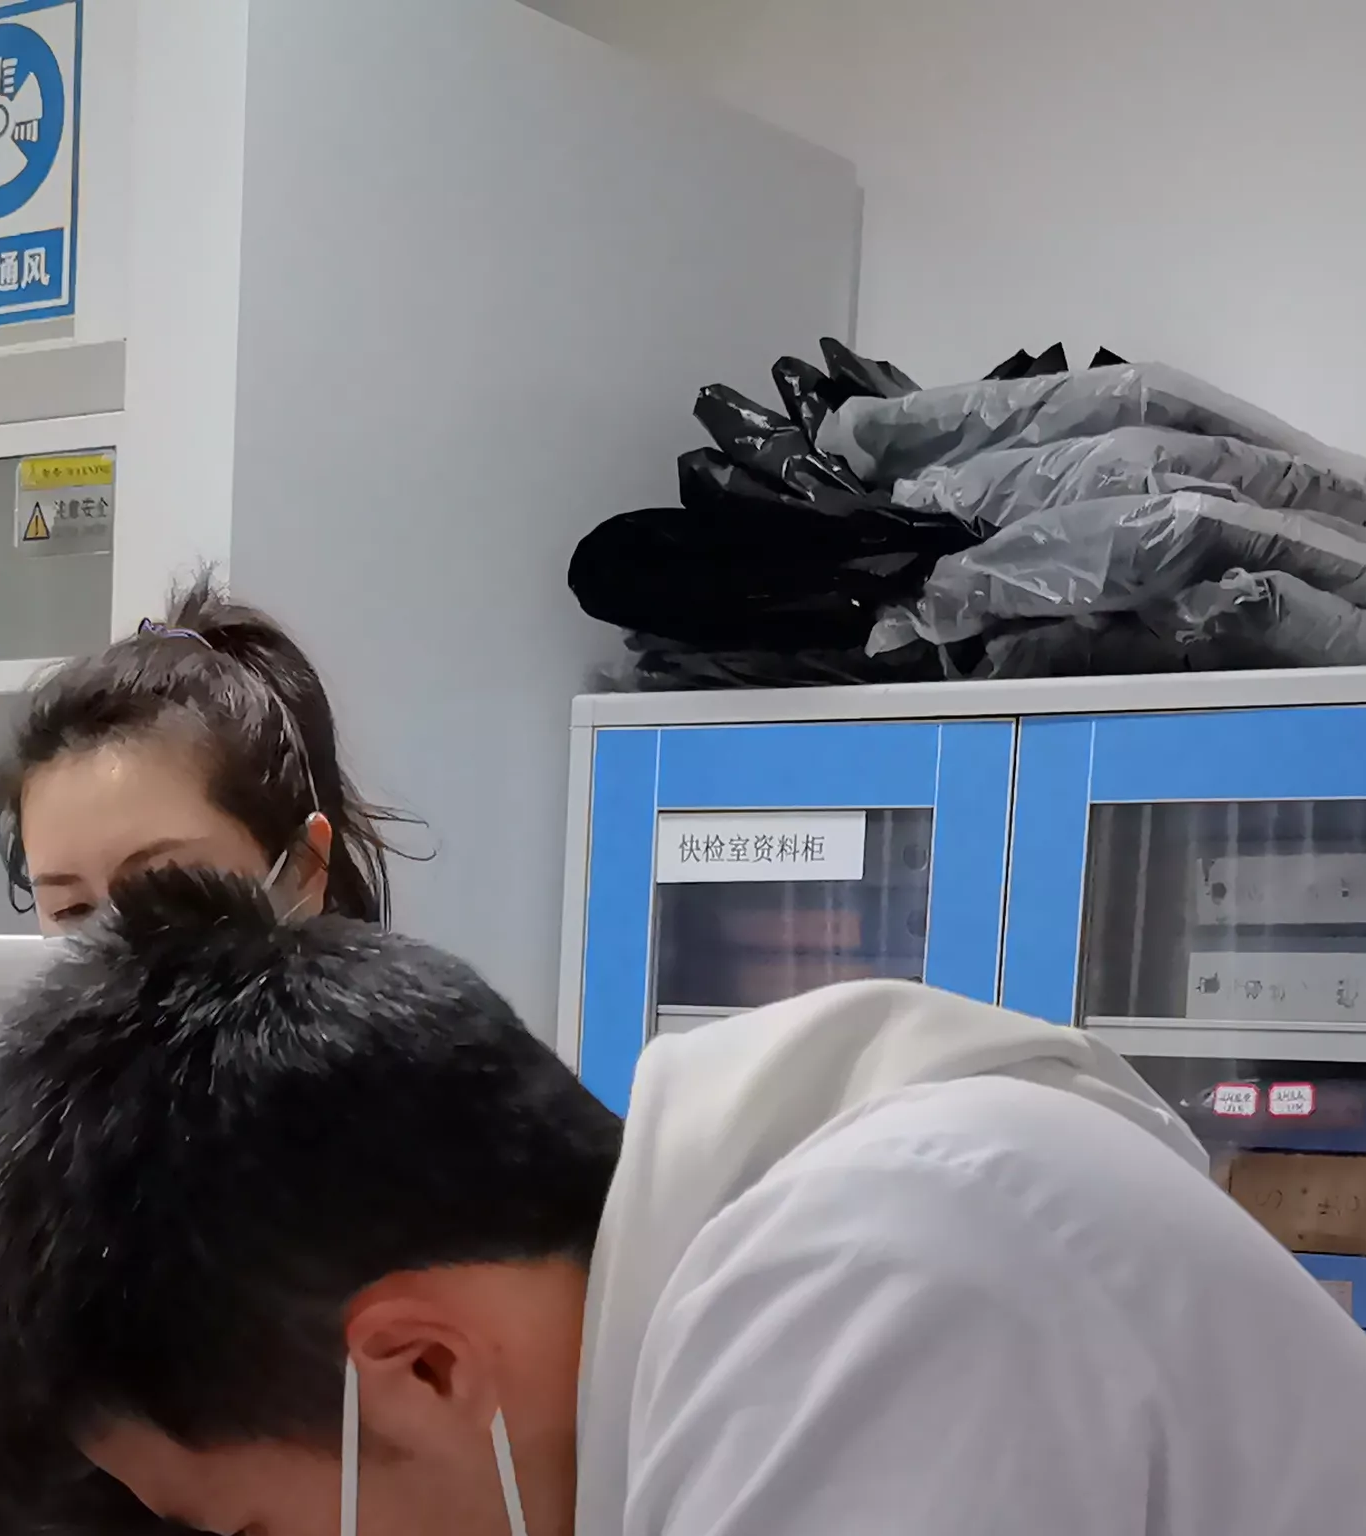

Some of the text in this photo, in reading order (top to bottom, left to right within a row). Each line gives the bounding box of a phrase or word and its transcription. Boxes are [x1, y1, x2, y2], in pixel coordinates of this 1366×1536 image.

[679, 833, 825, 863] 快检室资料柜
